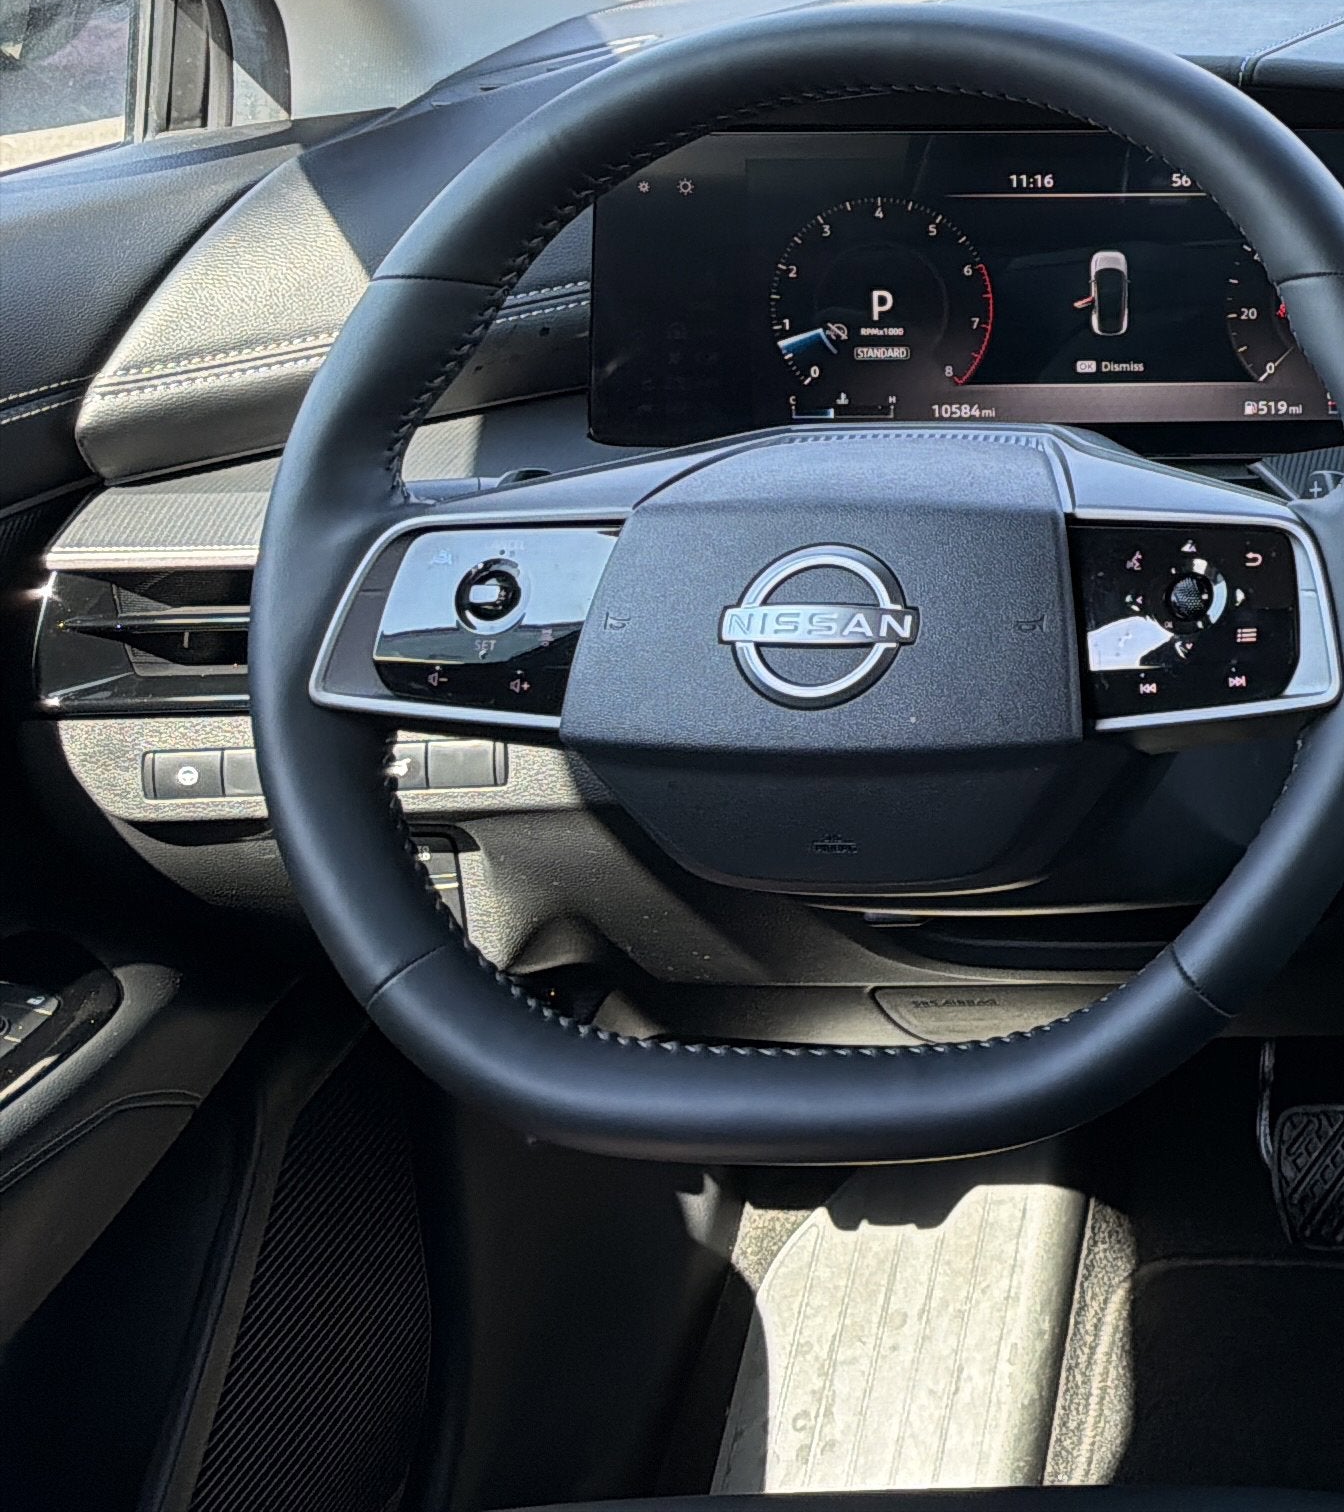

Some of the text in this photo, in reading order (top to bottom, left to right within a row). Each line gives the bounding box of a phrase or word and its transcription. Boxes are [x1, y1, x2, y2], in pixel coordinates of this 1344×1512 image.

[1008, 174, 1054, 188] 11:16
[1171, 174, 1192, 187] 56
[874, 207, 884, 219] 4
[822, 225, 831, 237] 3
[928, 225, 937, 236] 5
[788, 266, 797, 278] 2
[963, 265, 973, 276] 6
[871, 290, 894, 321] P
[1240, 308, 1257, 320] 20
[782, 319, 790, 330] 1
[971, 318, 980, 329] 7
[857, 348, 907, 358] STANDARD
[810, 365, 820, 377] 0
[944, 365, 954, 377] 8
[1101, 361, 1144, 372] Dismiss
[1266, 363, 1275, 374] 0
[789, 395, 896, 405] C H
[728, 612, 913, 638] NISSAN
[474, 640, 496, 651] SET
